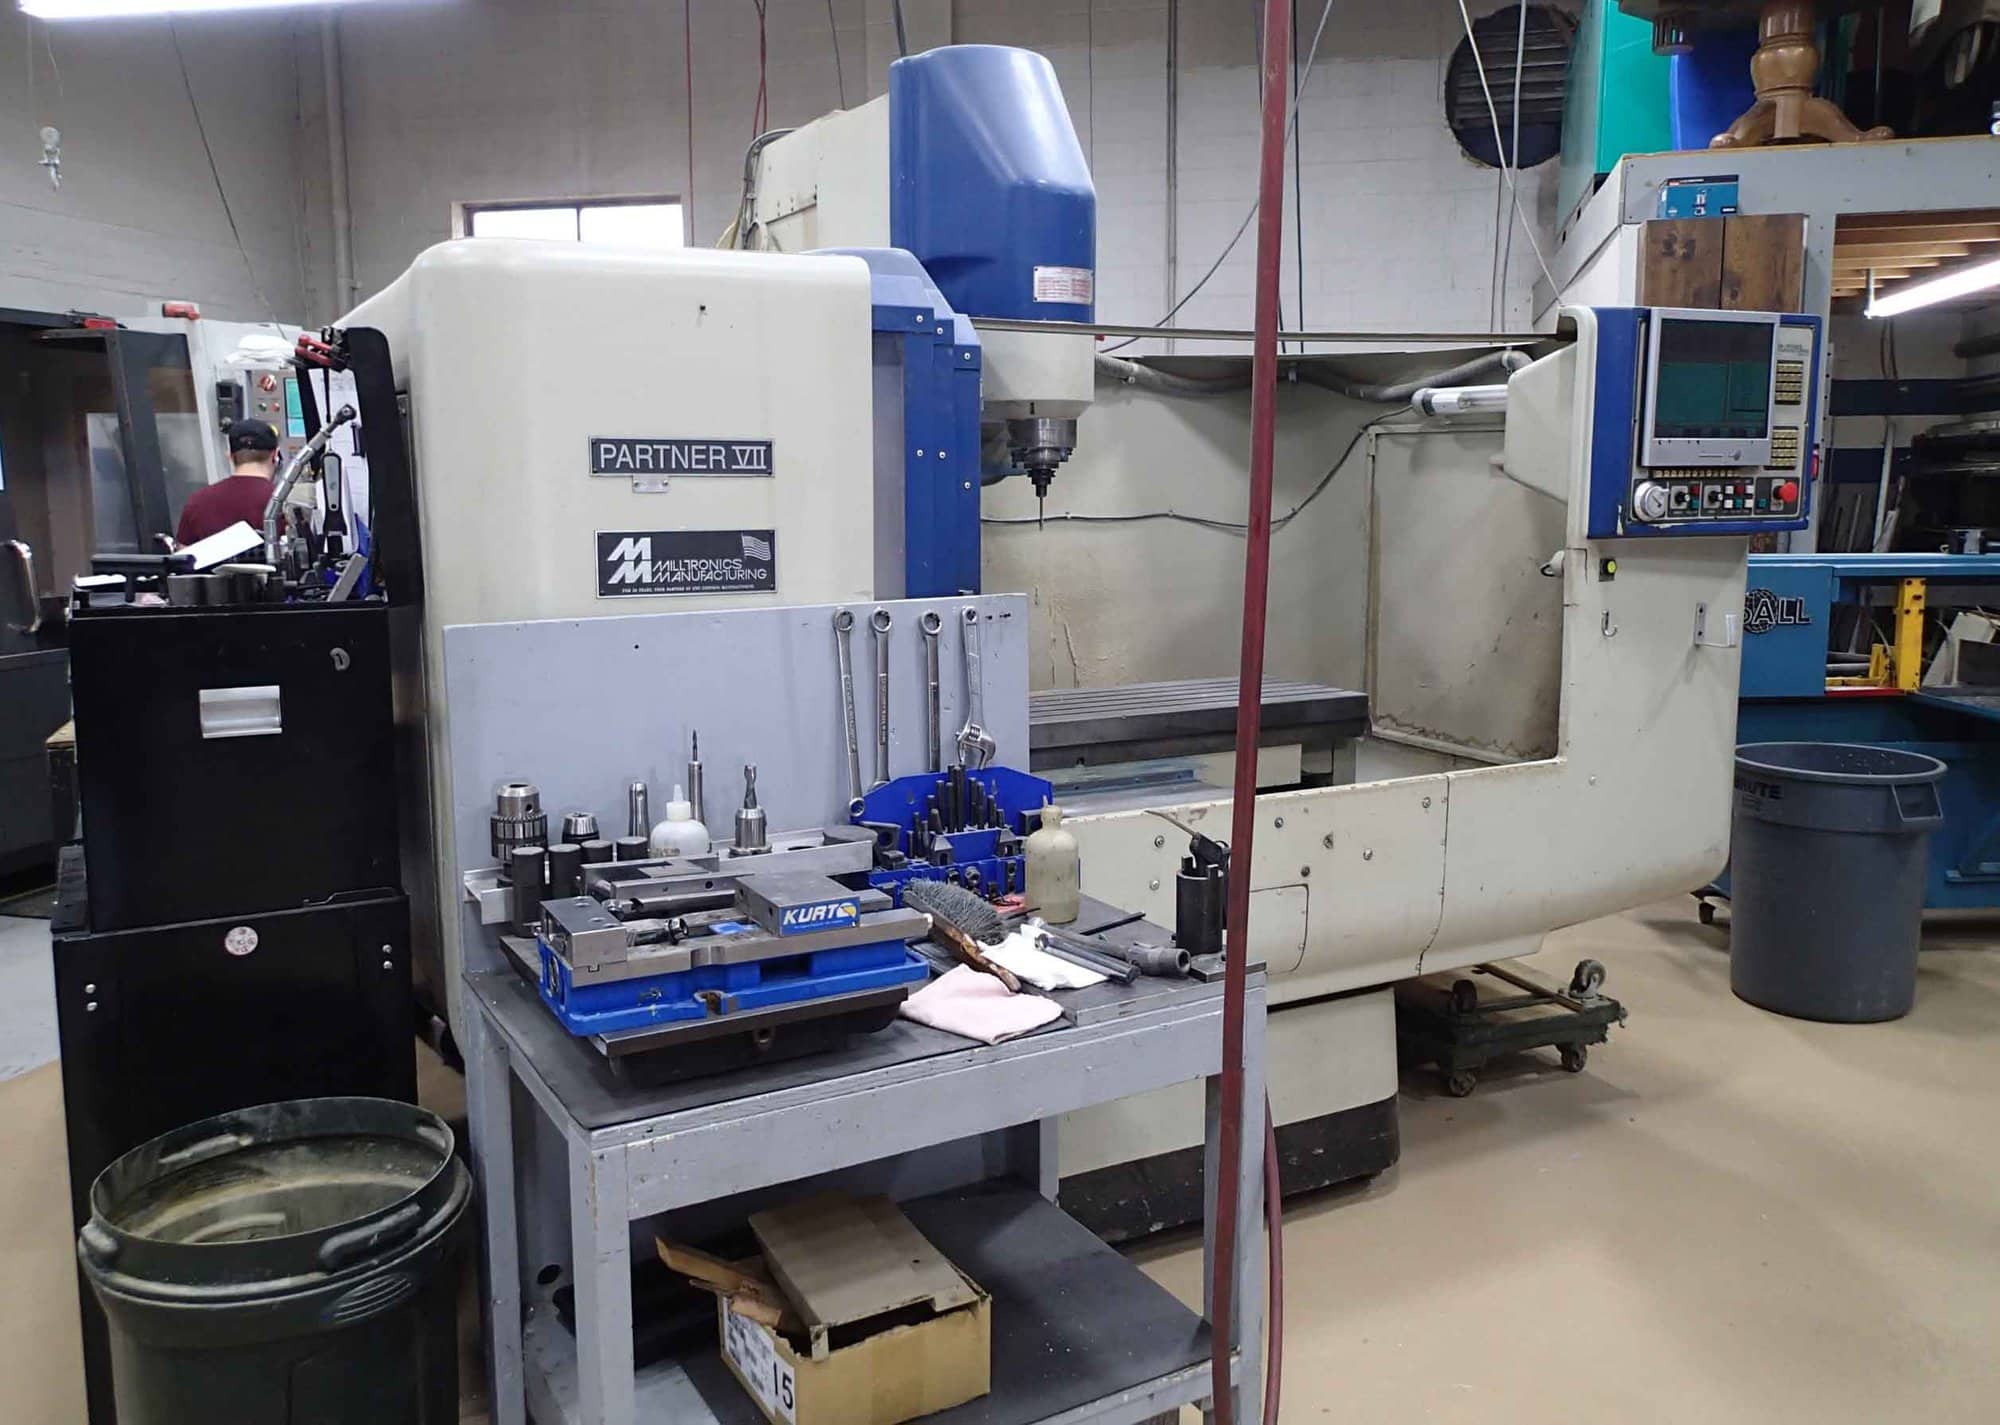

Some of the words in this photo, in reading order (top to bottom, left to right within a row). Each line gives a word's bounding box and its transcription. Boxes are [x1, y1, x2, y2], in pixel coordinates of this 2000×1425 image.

[600, 443, 726, 469] PARTNER
[731, 445, 767, 470] VII
[652, 558, 743, 573] MILLTRONICS
[652, 568, 767, 583] MANUFACTURING
[782, 903, 840, 925] KURT
